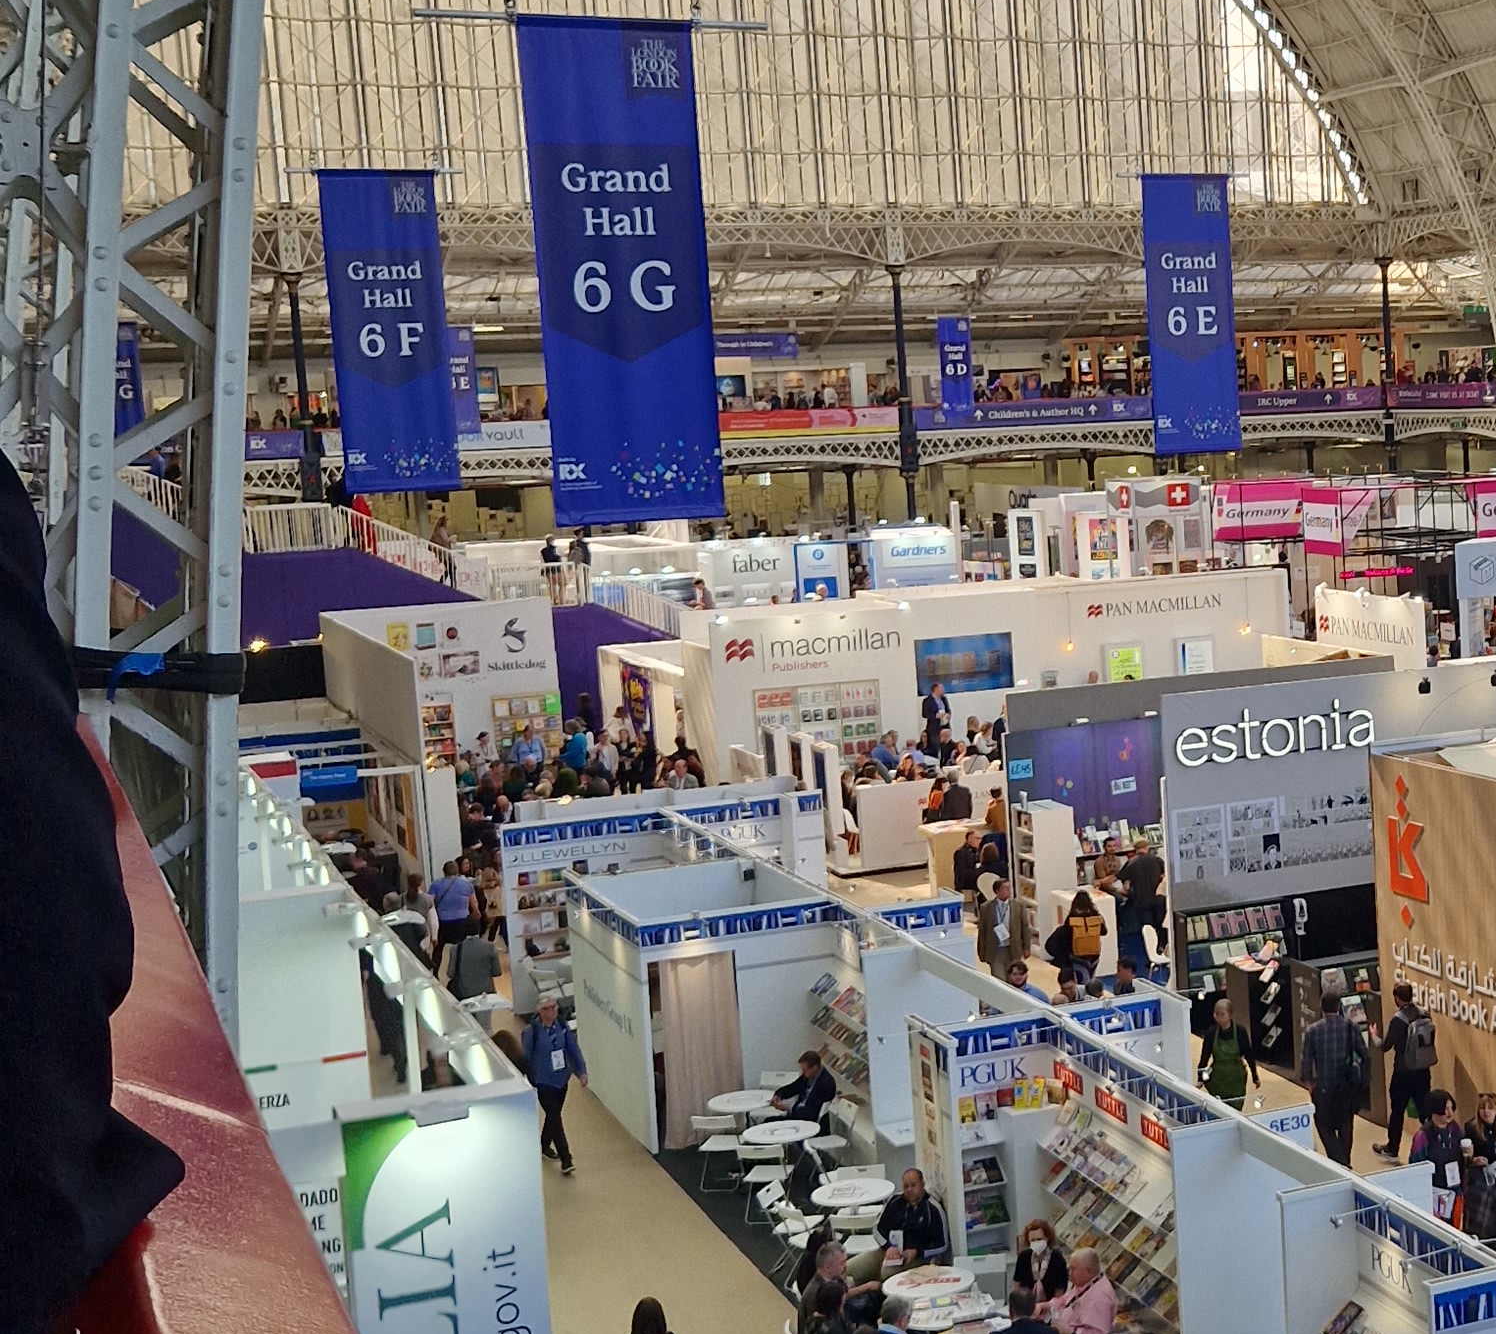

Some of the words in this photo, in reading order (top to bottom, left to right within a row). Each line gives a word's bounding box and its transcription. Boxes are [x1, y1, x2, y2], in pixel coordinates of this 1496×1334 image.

[631, 47, 678, 58] LONDON
[640, 39, 665, 49] THE
[632, 57, 679, 74] BOOK
[632, 71, 680, 89] FAIR
[561, 163, 672, 193] Grand
[583, 207, 657, 236] Hall
[1161, 252, 1217, 269] Grand
[347, 261, 422, 280] Grand
[574, 261, 612, 313] 6
[630, 260, 676, 312] G
[1172, 276, 1209, 294] Hall
[363, 288, 412, 308] Hall
[1167, 307, 1187, 336] 6
[1197, 306, 1218, 335] E
[359, 324, 386, 358] 6
[400, 322, 424, 356] F
[944, 344, 966, 352] Grand
[450, 356, 469, 364] rand
[946, 364, 955, 376] 6
[957, 363, 967, 376] D
[119, 384, 134, 399] G
[1273, 397, 1297, 408] Upper
[988, 408, 1031, 419] Children's
[1039, 407, 1069, 418] Author
[1070, 406, 1084, 417] HQ
[459, 428, 525, 443] ookvault
[1226, 505, 1290, 521] Germany
[1304, 510, 1334, 536] Germany
[891, 544, 947, 557] Gardners
[732, 553, 781, 574] faber
[1106, 601, 1134, 618] PAN
[1139, 593, 1222, 615] MACMILLAN
[1331, 616, 1353, 636] PAN
[1355, 619, 1416, 646] MACMILLAN
[770, 628, 901, 659] macmillan
[487, 657, 547, 672] Skittledog
[772, 659, 829, 672] Publishers
[1176, 698, 1376, 767] estonia
[721, 823, 767, 841] PGUK
[520, 841, 627, 864] LLEWELLYN
[1392, 938, 1442, 978] للكتاب
[1394, 968, 1447, 1014] Sarjah
[1450, 989, 1487, 1029] Book
[960, 1056, 1028, 1088] PGUK
[259, 1093, 290, 1110] ERZA
[1096, 1089, 1127, 1122] TUTTLE
[1270, 1114, 1311, 1133] 6E30
[1370, 1243, 1413, 1295] PGUK
